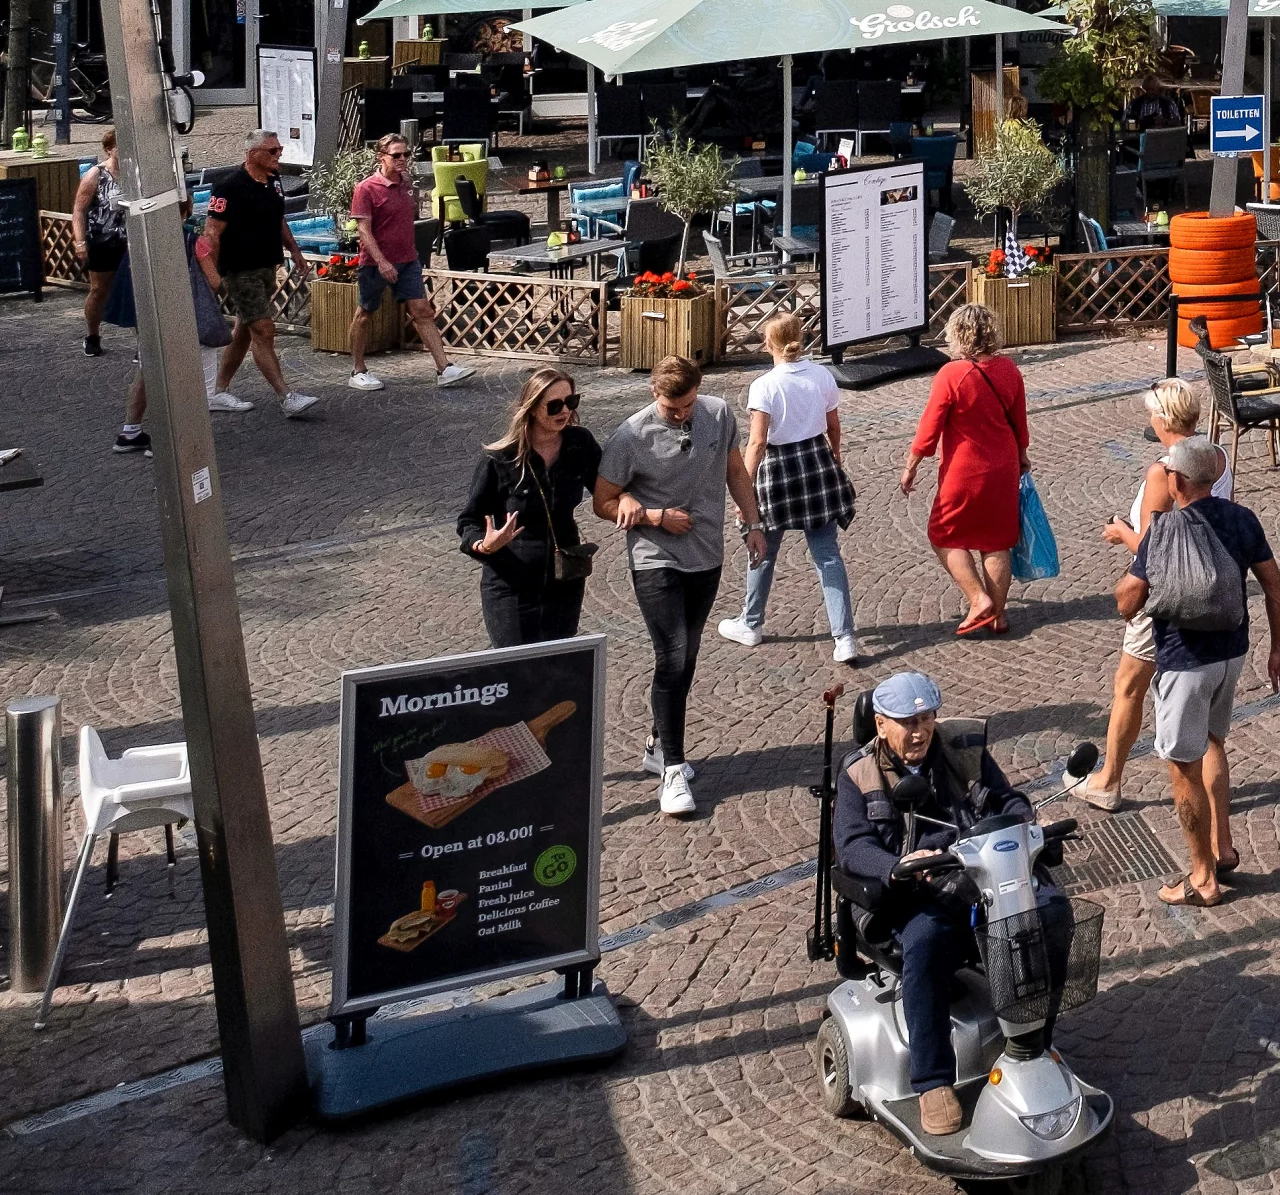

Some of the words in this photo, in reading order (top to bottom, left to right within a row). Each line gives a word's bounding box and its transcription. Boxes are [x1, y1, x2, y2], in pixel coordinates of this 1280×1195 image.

[850, 5, 982, 40] Grolsch
[1216, 108, 1261, 120] TOILETTEN
[379, 682, 510, 718] Mornings
[421, 841, 464, 859] Open
[467, 836, 483, 849] at
[486, 824, 534, 845] 08.00!
[479, 862, 528, 880] Breakfast
[542, 860, 569, 879] Go
[479, 878, 513, 894] Panini
[478, 894, 507, 908] Fresh
[507, 890, 535, 904] Juice
[478, 906, 527, 923] Delicious
[528, 897, 560, 911] Coffee
[478, 926, 496, 937] Oat
[497, 919, 522, 933] Milk
